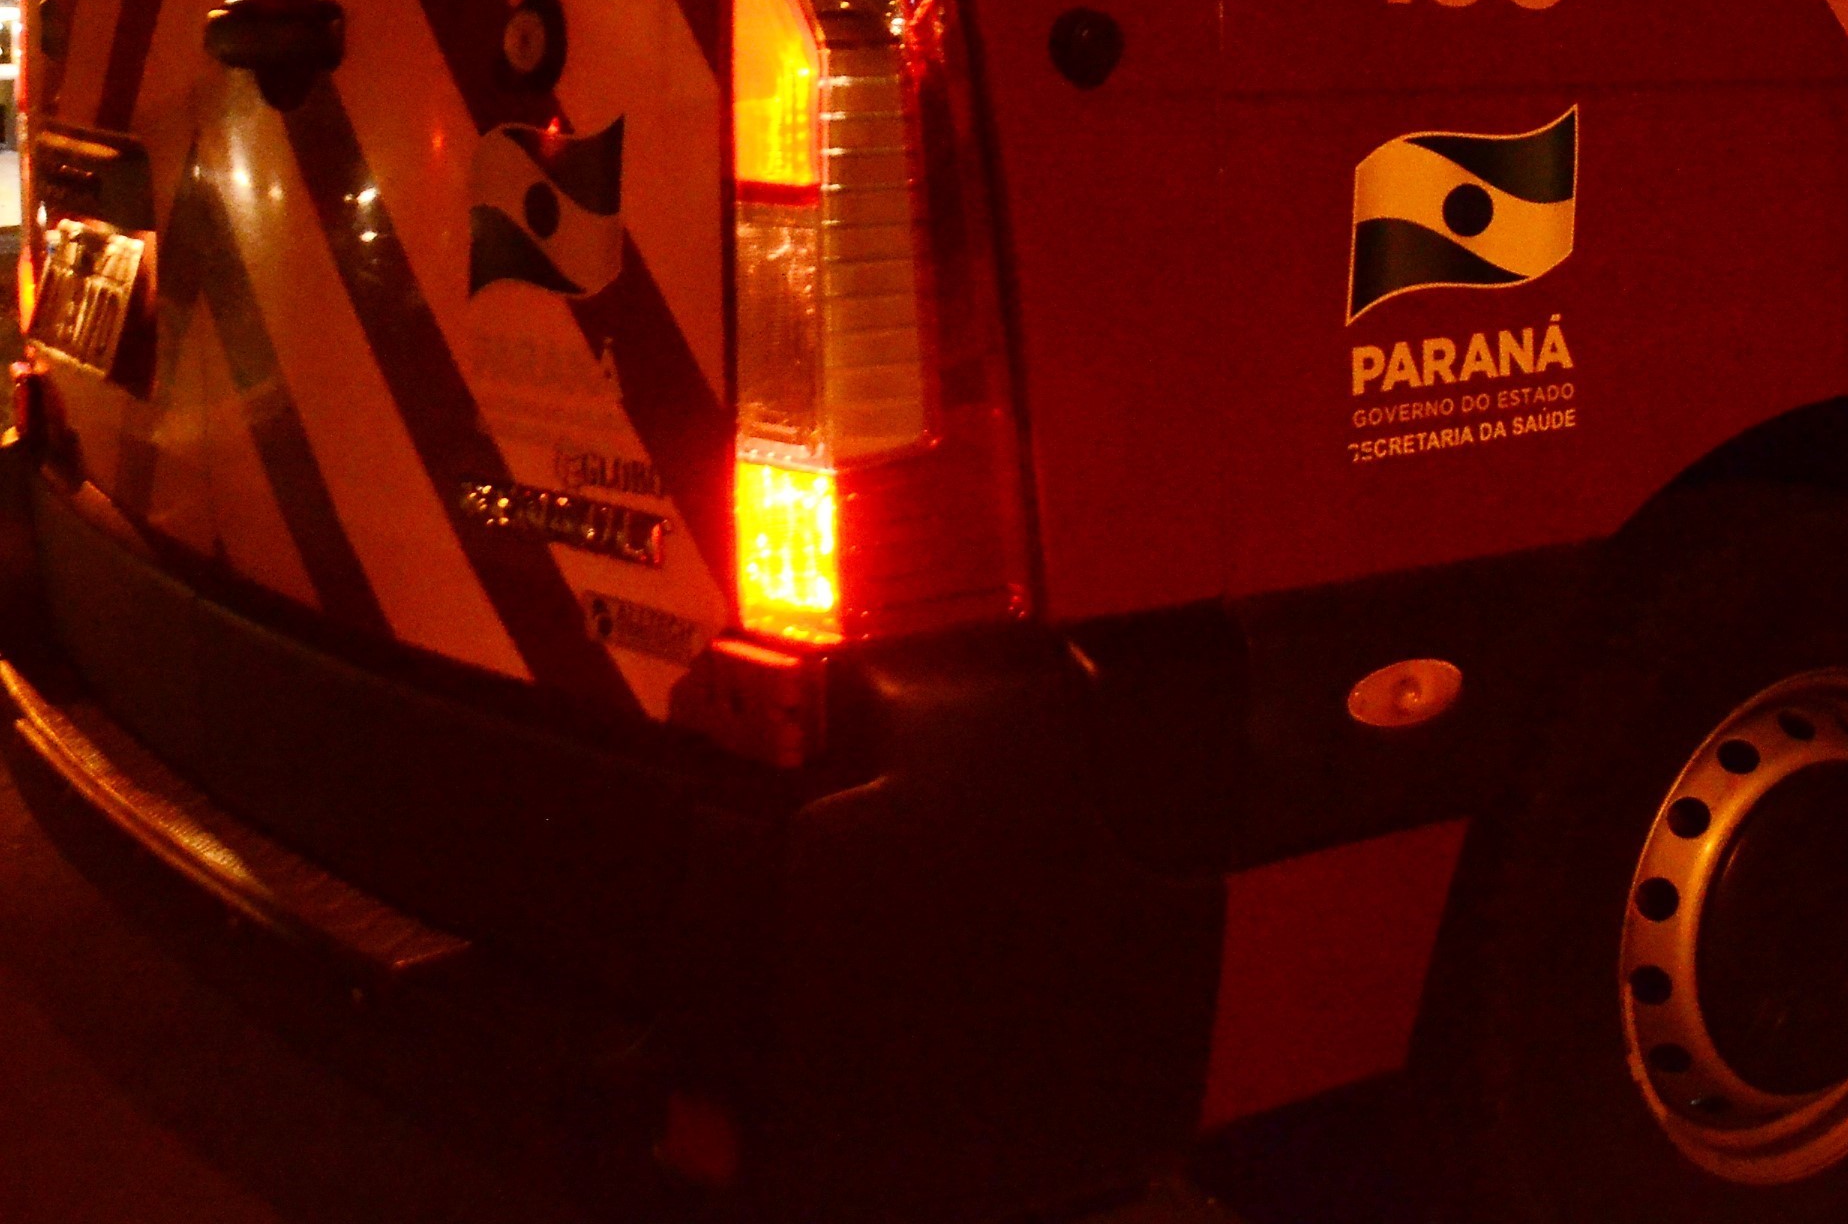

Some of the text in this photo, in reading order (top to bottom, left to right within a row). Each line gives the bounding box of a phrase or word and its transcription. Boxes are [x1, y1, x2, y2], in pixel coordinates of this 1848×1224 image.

[1352, 313, 1574, 396] PARANÁ
[1352, 382, 1575, 428] GOVERNO DO ESTADO
[1479, 421, 1507, 441] DA
[1512, 407, 1577, 436] SAÚDE
